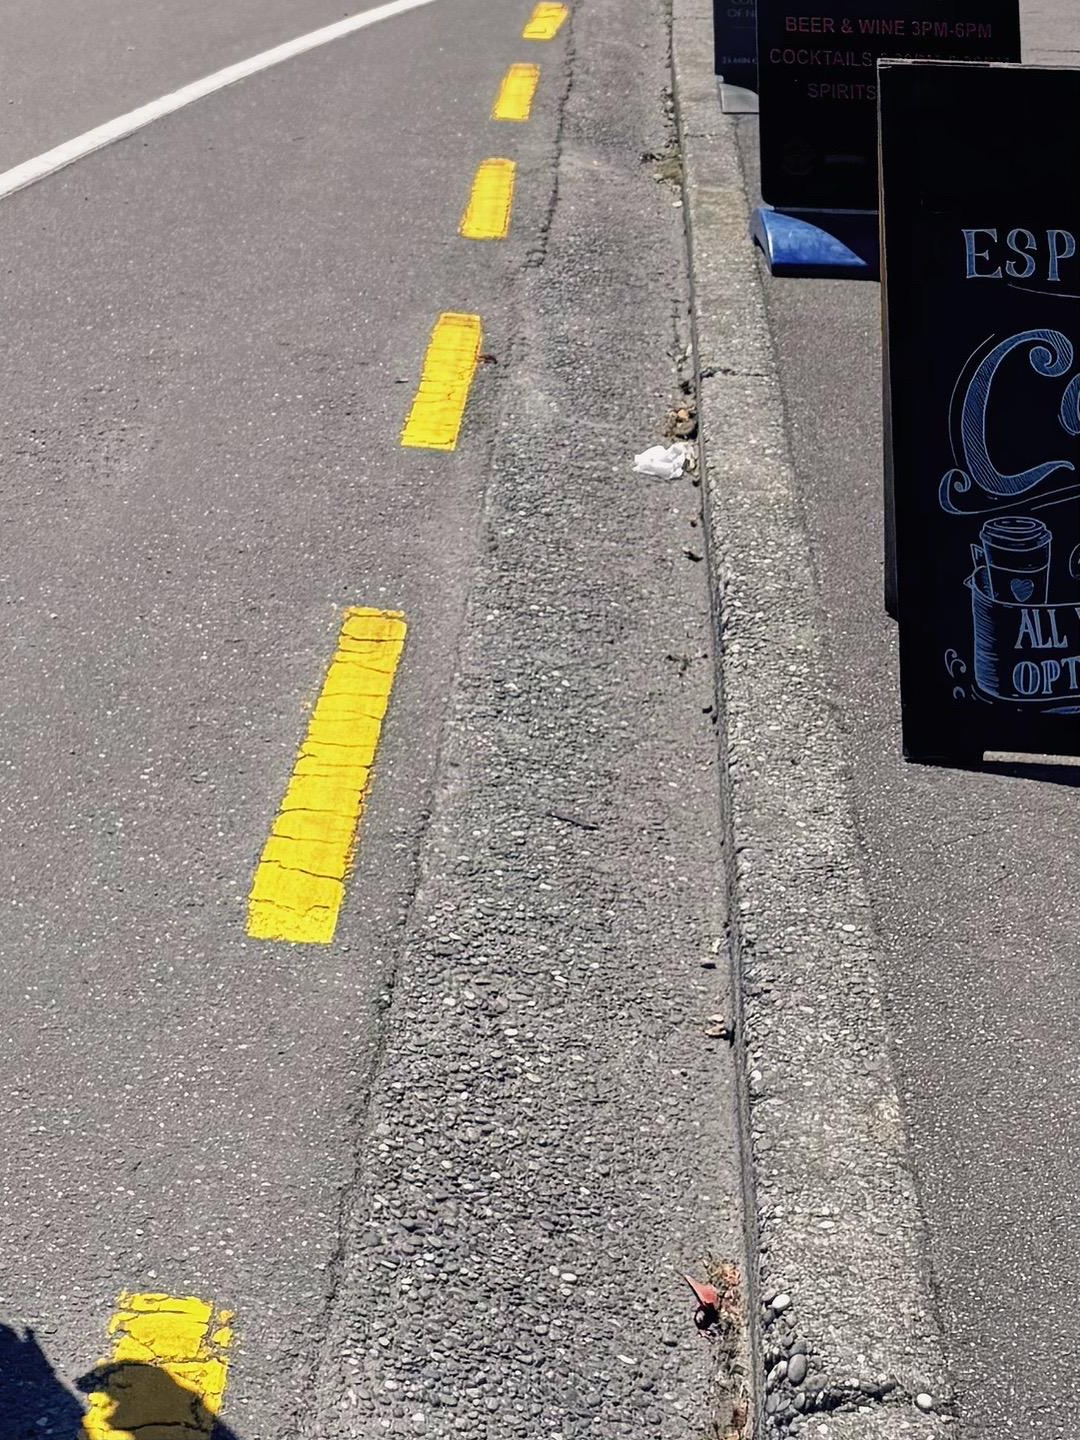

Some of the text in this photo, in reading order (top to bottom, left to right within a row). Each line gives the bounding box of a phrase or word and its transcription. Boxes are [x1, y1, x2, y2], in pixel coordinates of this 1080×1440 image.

[785, 16, 993, 39] BEER & WINE 3PM-6PM
[769, 48, 873, 67] COCKTAILS
[807, 83, 876, 101] SPIRITS
[960, 228, 1077, 282] ESP
[1014, 608, 1069, 649] ALL
